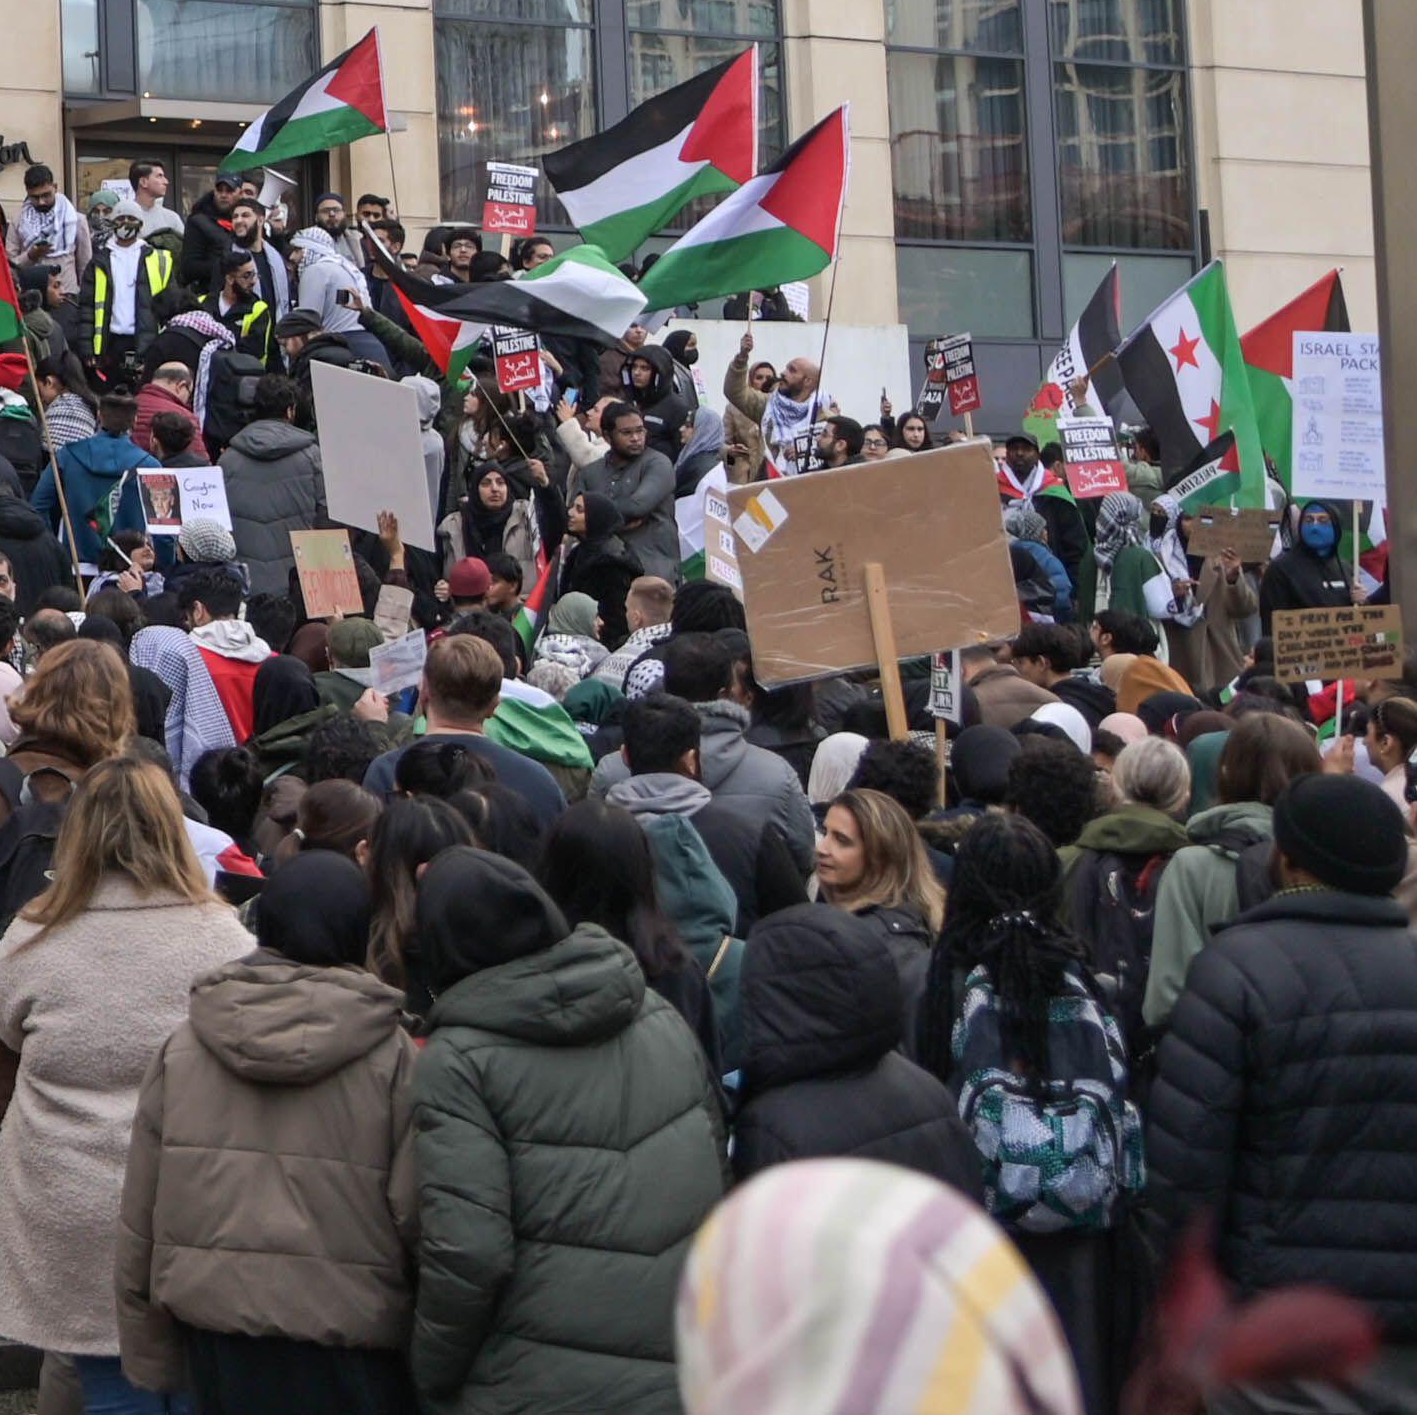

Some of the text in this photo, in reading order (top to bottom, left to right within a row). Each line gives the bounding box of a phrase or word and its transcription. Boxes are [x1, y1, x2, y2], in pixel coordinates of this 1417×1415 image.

[491, 172, 533, 188] FREEDOM
[487, 189, 534, 205] PALESTINE
[497, 336, 536, 356] PALESTINE
[1300, 342, 1352, 357] ISRAEL
[1340, 357, 1378, 371] PACK
[1065, 427, 1111, 444] FREEDOM
[1065, 446, 1117, 463] PALESTINE
[708, 498, 727, 519] STOP
[711, 558, 736, 581] PALEST
[813, 545, 840, 604] RAK
